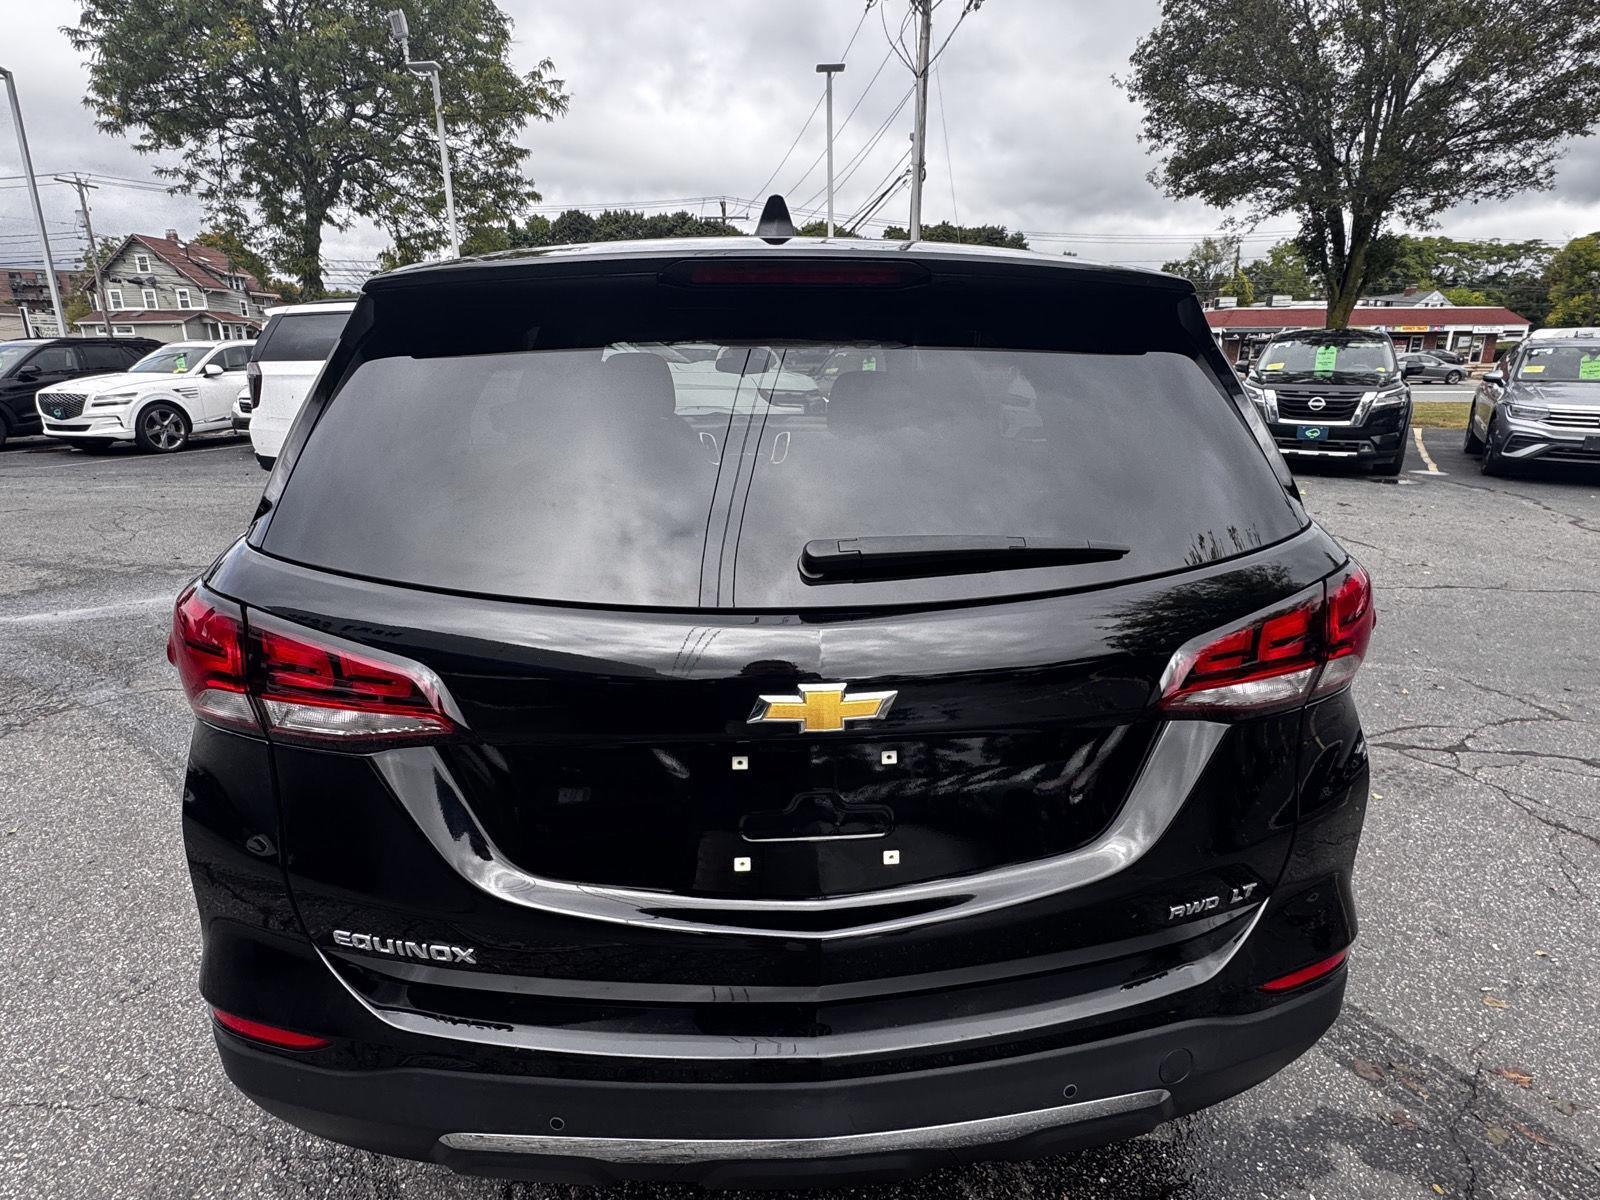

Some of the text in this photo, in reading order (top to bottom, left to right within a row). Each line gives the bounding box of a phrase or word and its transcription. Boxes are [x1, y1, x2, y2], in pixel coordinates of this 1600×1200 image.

[1169, 882, 1257, 920] AWD LT
[333, 930, 476, 964] EQUINOX
